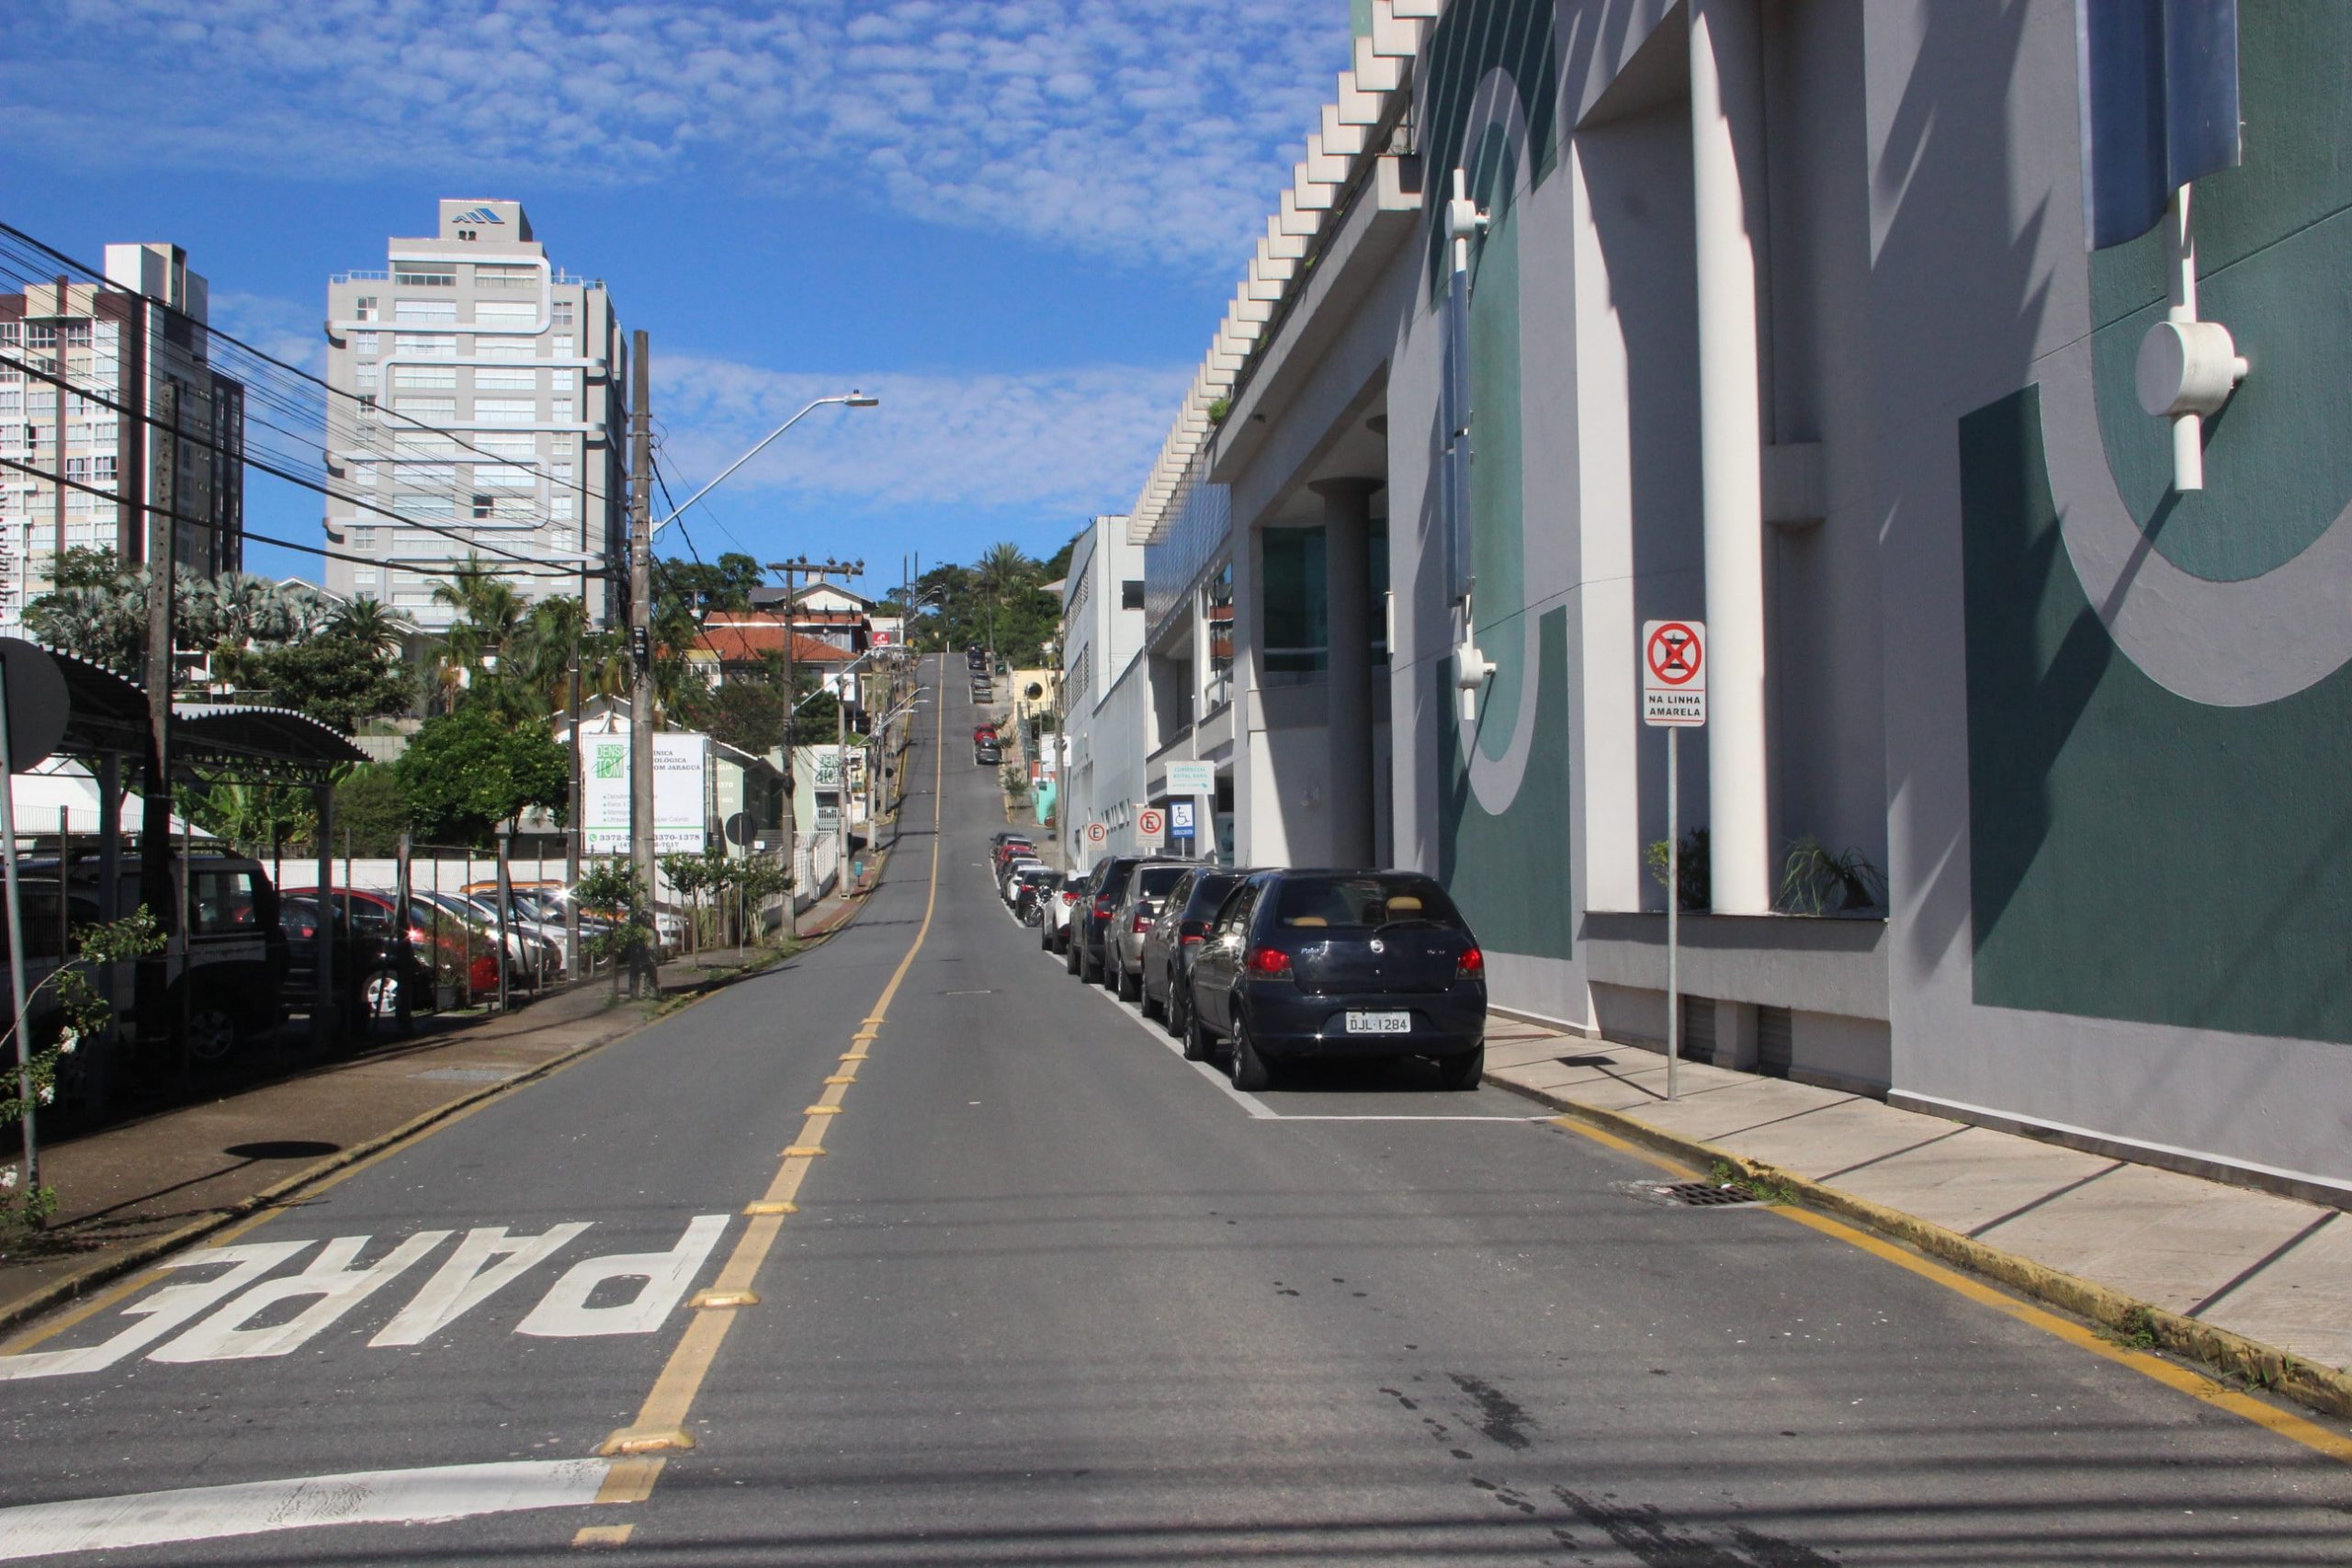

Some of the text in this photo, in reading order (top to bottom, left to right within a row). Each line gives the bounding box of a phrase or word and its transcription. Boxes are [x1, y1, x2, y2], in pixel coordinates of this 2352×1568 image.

[1648, 695, 1701, 705] NA LINHA
[1649, 707, 1701, 716] AMARELA
[667, 763, 701, 772] JARAGUÁ
[1092, 827, 1101, 839] E
[0, 1214, 731, 1380] PARE
